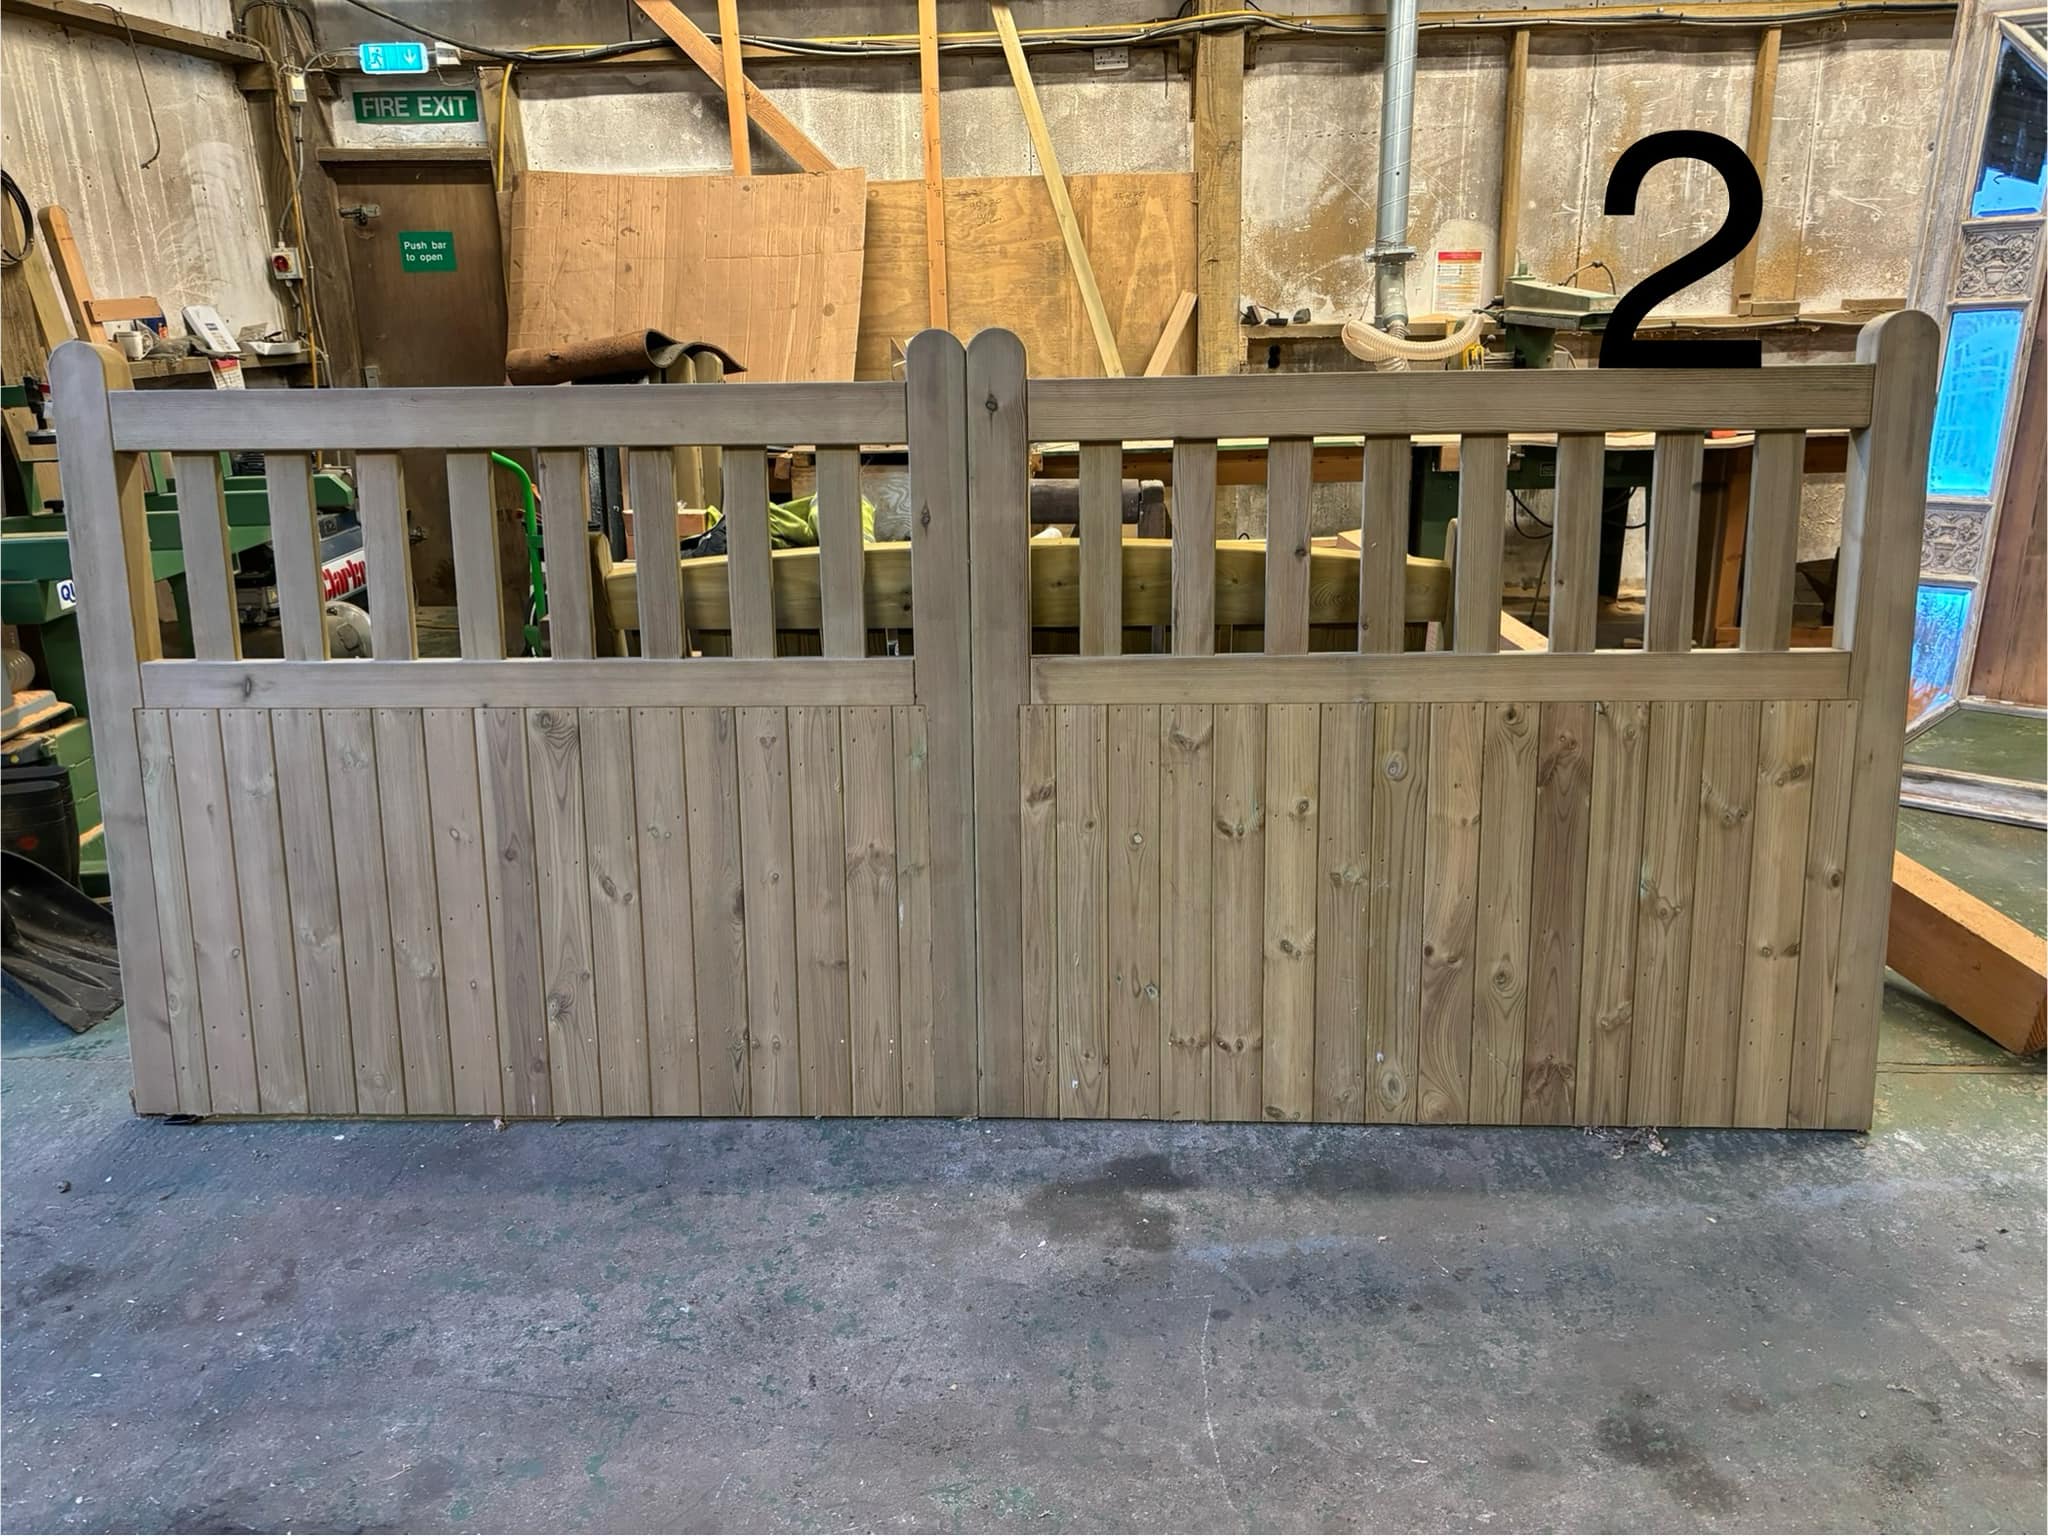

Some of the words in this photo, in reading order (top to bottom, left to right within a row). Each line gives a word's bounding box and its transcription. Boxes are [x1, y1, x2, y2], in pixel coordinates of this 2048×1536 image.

[361, 96, 410, 117] FIRE
[417, 96, 468, 117] EXIT
[403, 240, 427, 250] Push
[431, 240, 447, 250] bar
[405, 253, 416, 262] to
[419, 253, 443, 263] open
